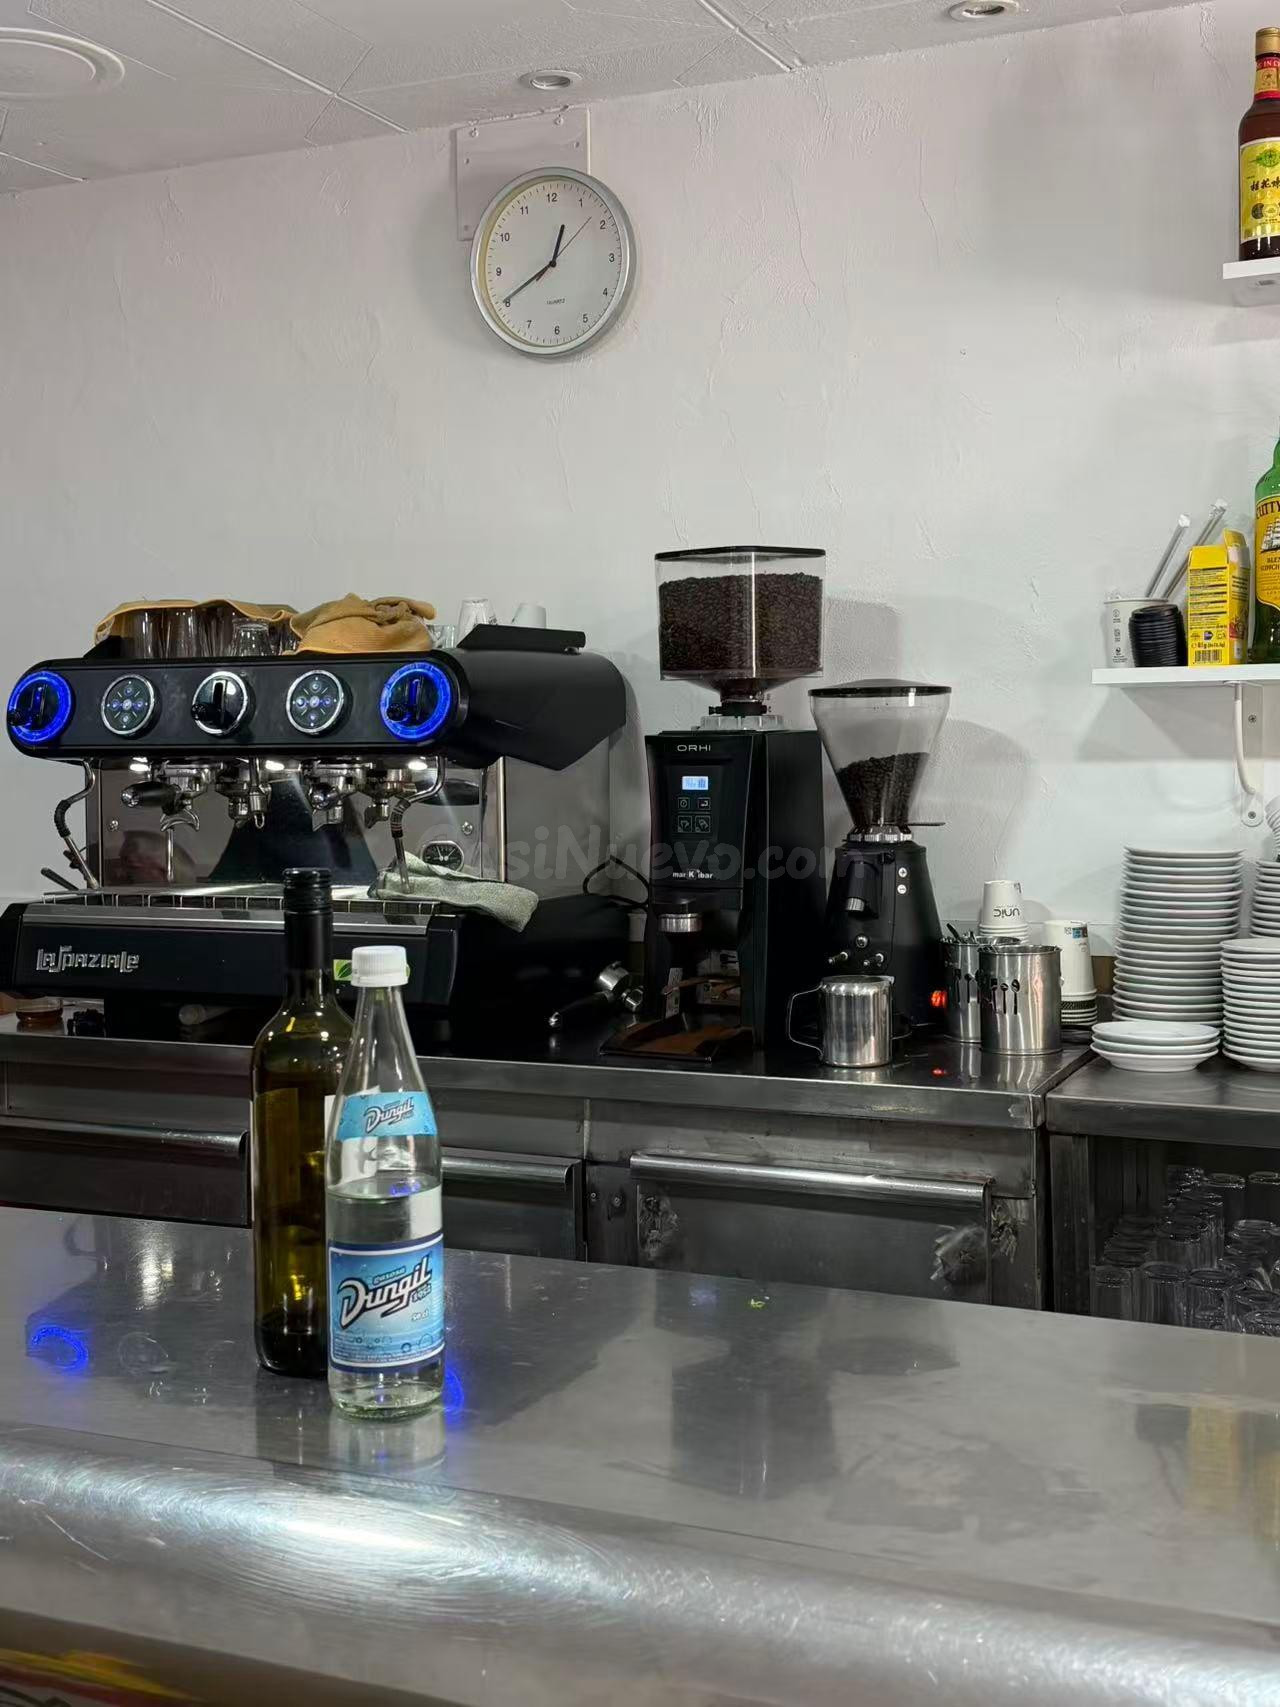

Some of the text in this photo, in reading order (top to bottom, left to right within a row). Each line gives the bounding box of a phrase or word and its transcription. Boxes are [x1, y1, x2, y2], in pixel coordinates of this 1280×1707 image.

[547, 193, 558, 203] 12
[579, 199, 584, 207] 1
[520, 206, 529, 215] 11
[600, 220, 606, 230] 2
[500, 232, 510, 242] 10
[609, 253, 615, 263] 3
[496, 268, 502, 277] 9
[603, 288, 608, 297] 4
[504, 299, 511, 308] 8
[583, 314, 588, 323] 5
[527, 320, 532, 329] 7
[554, 326, 560, 335] 6
[677, 744, 711, 752] ORHI
[363, 1096, 415, 1134] Dungil
[337, 1251, 432, 1330] Dungil
